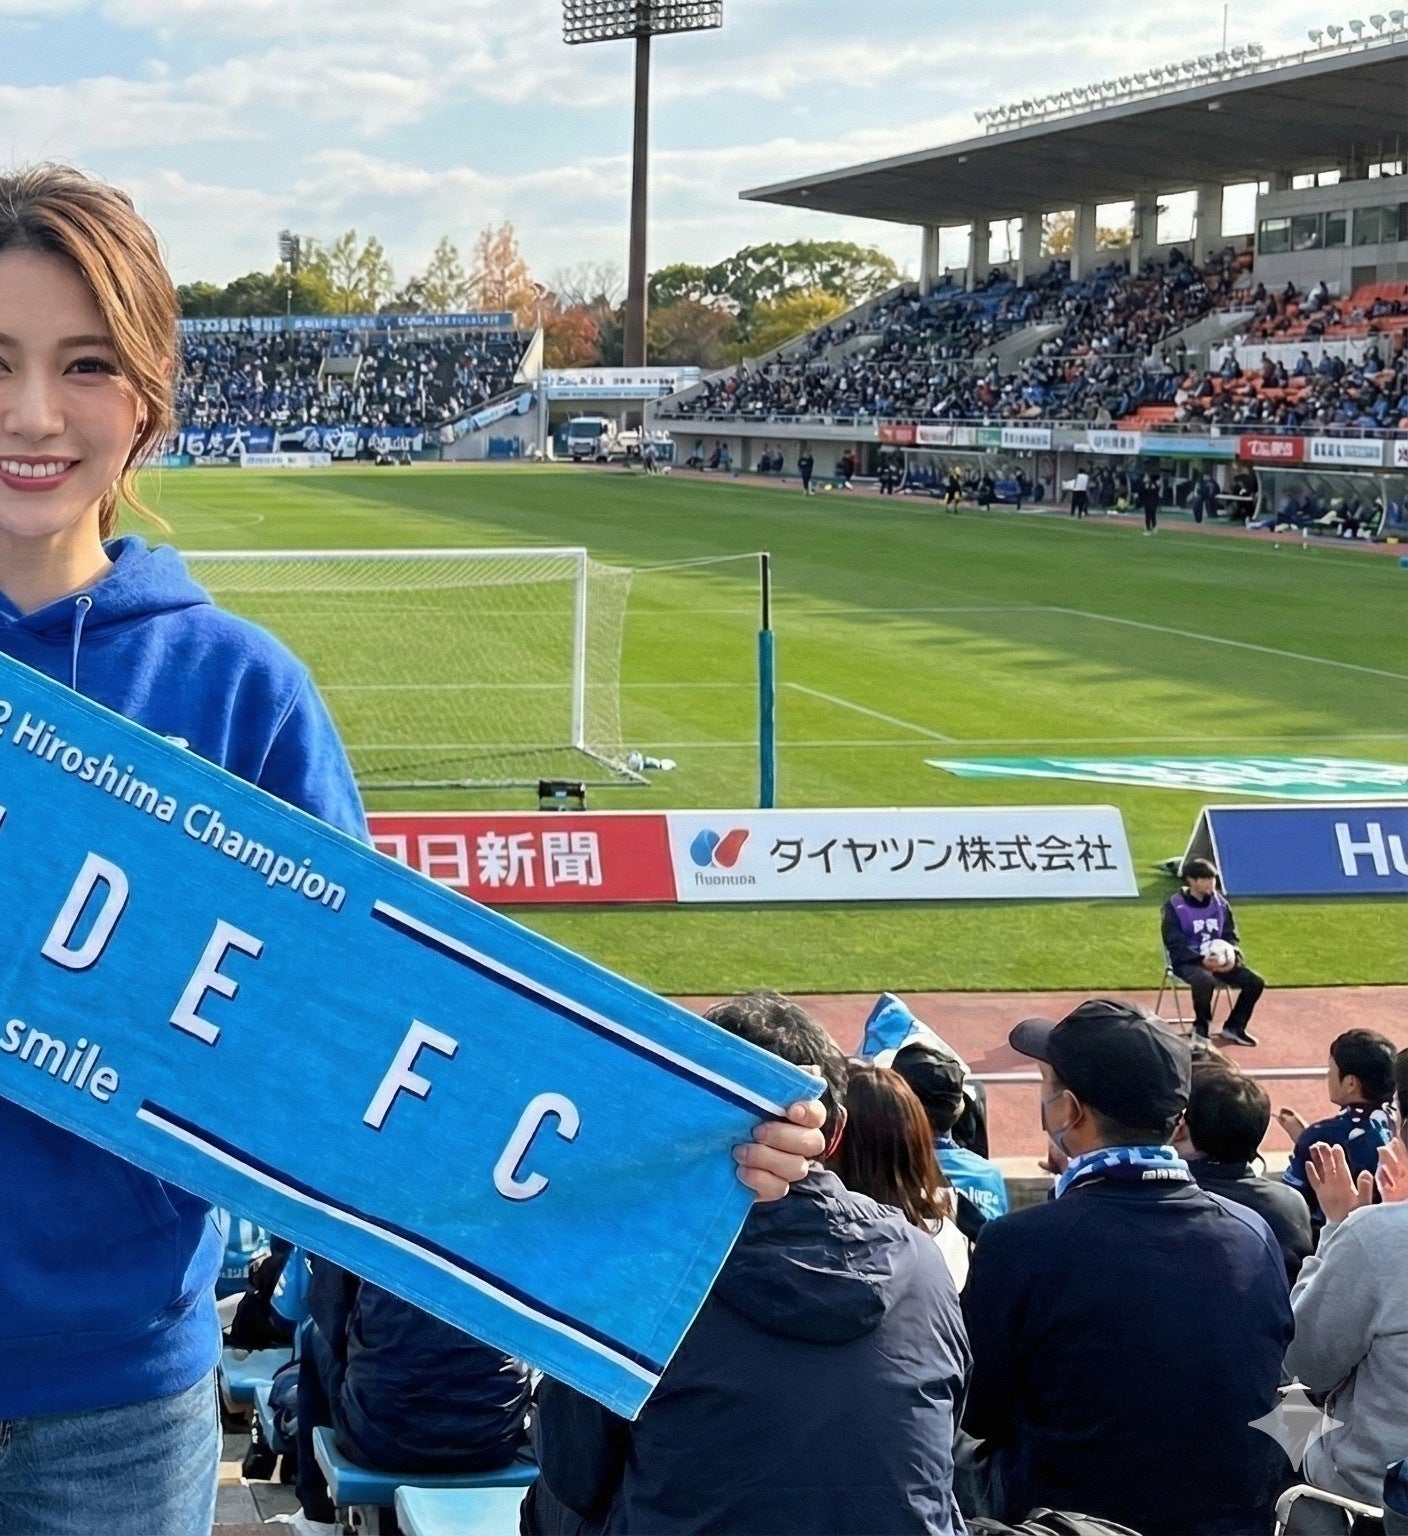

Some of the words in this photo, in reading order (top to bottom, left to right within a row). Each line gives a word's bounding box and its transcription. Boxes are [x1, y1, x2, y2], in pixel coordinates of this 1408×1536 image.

[12, 711, 179, 823] Hiroshima
[183, 803, 347, 911] Champion
[362, 1018, 581, 1201] FC
